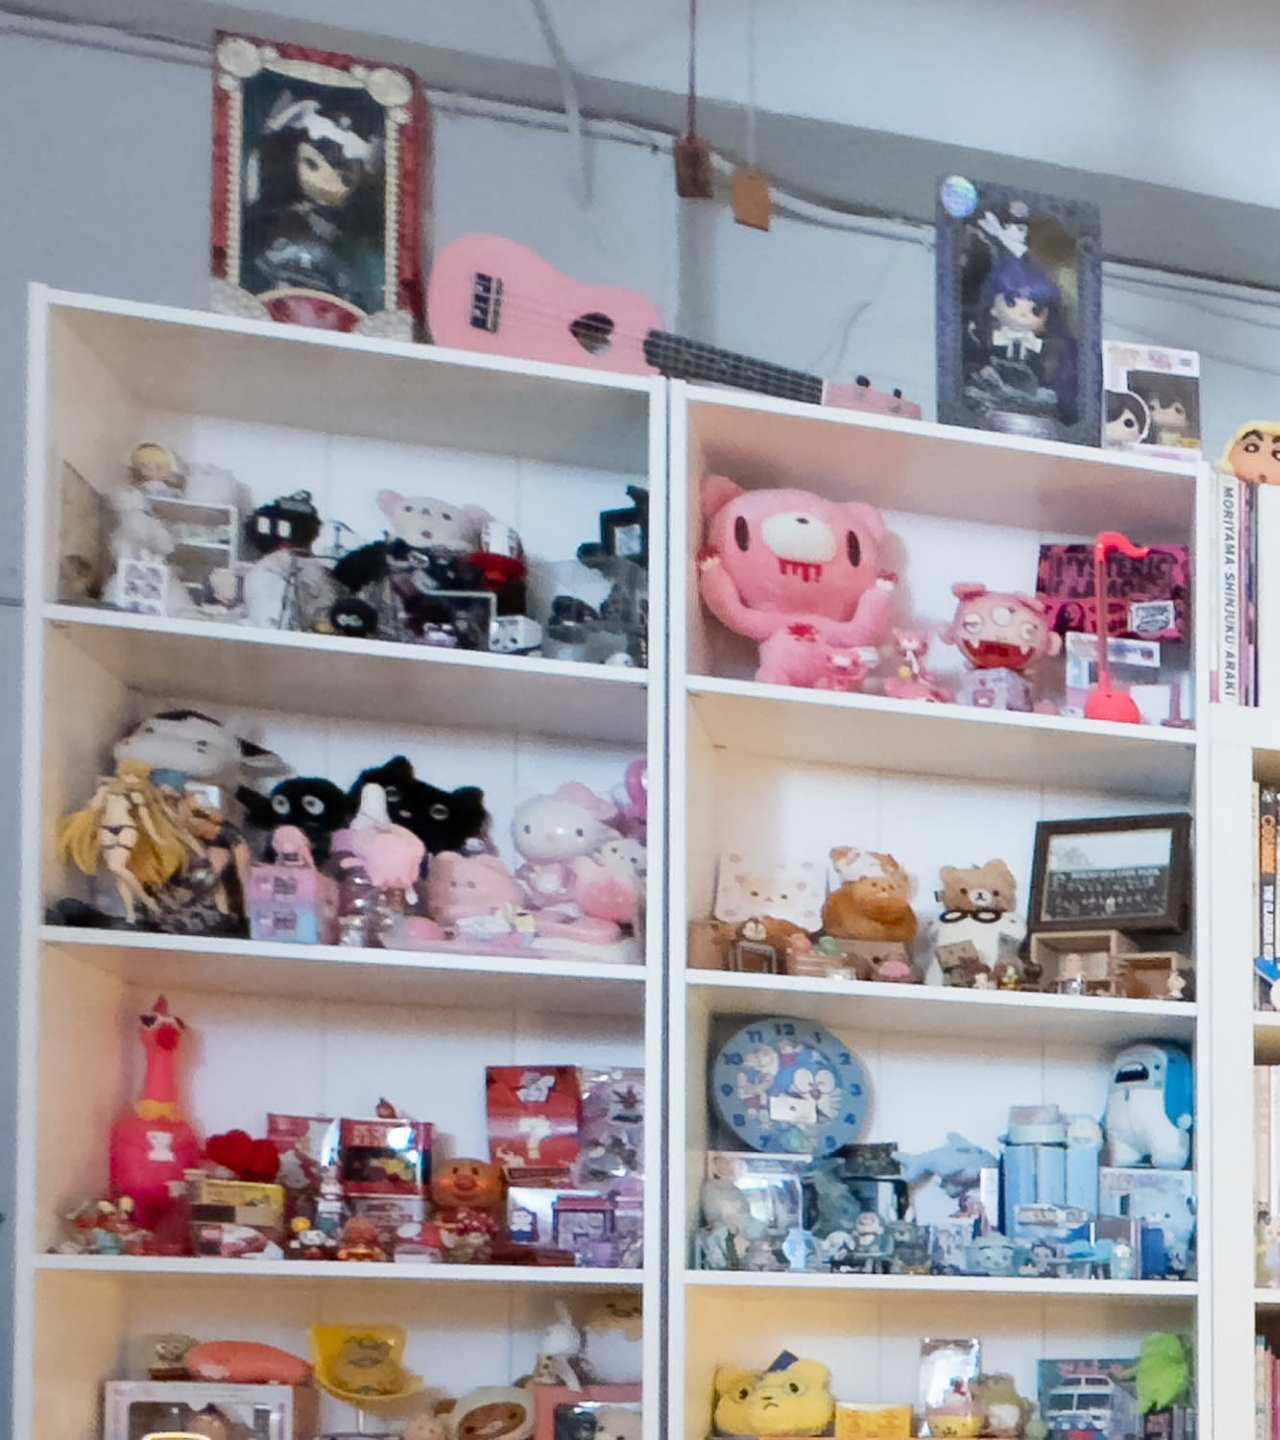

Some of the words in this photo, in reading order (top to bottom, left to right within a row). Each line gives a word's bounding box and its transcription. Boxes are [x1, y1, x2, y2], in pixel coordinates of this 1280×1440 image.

[773, 1023, 796, 1037] 12
[839, 1052, 852, 1066] 2
[850, 1083, 863, 1097] 3
[844, 1113, 857, 1126] 4
